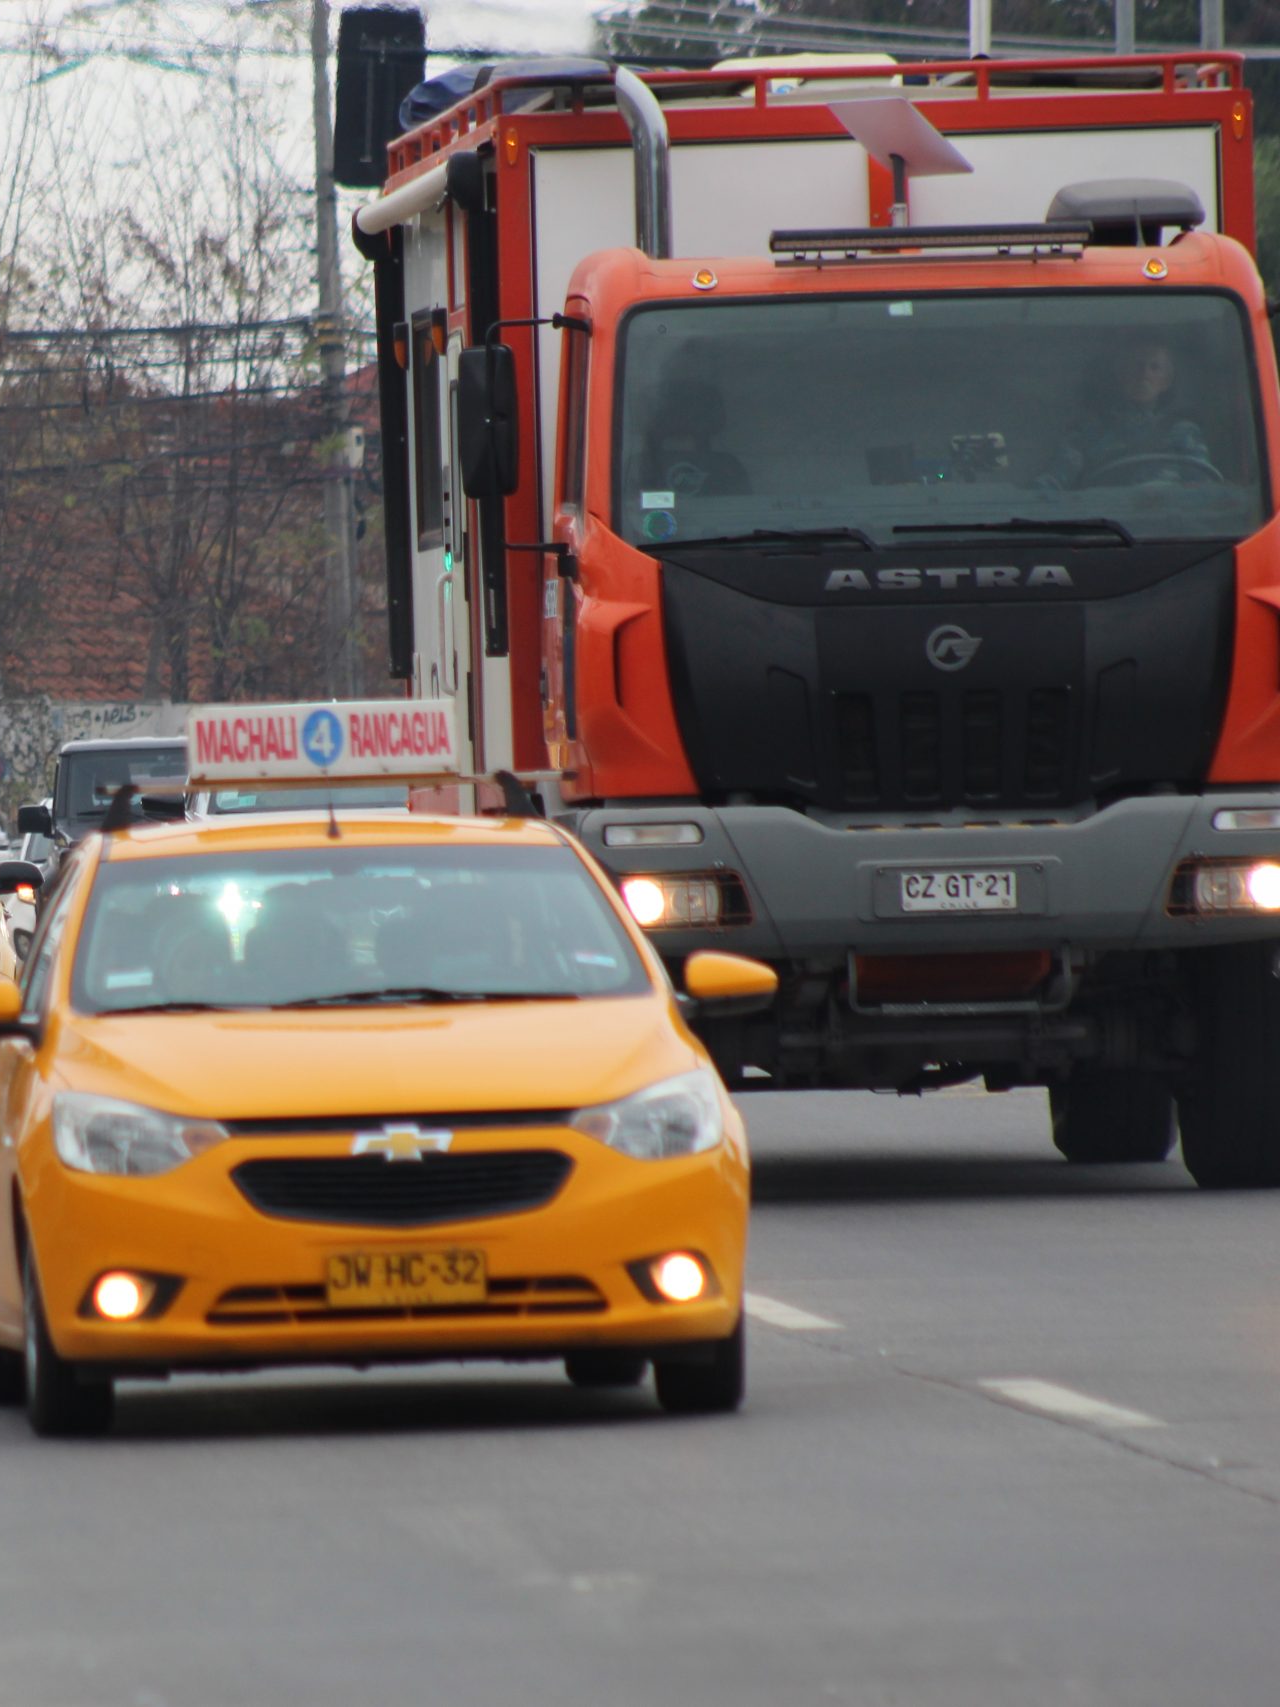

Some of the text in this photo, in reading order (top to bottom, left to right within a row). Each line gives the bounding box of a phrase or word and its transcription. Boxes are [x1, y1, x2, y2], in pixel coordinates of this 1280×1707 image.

[823, 564, 1075, 591] ASTRA
[195, 711, 451, 764] MACHALI 4 RANCAGUA
